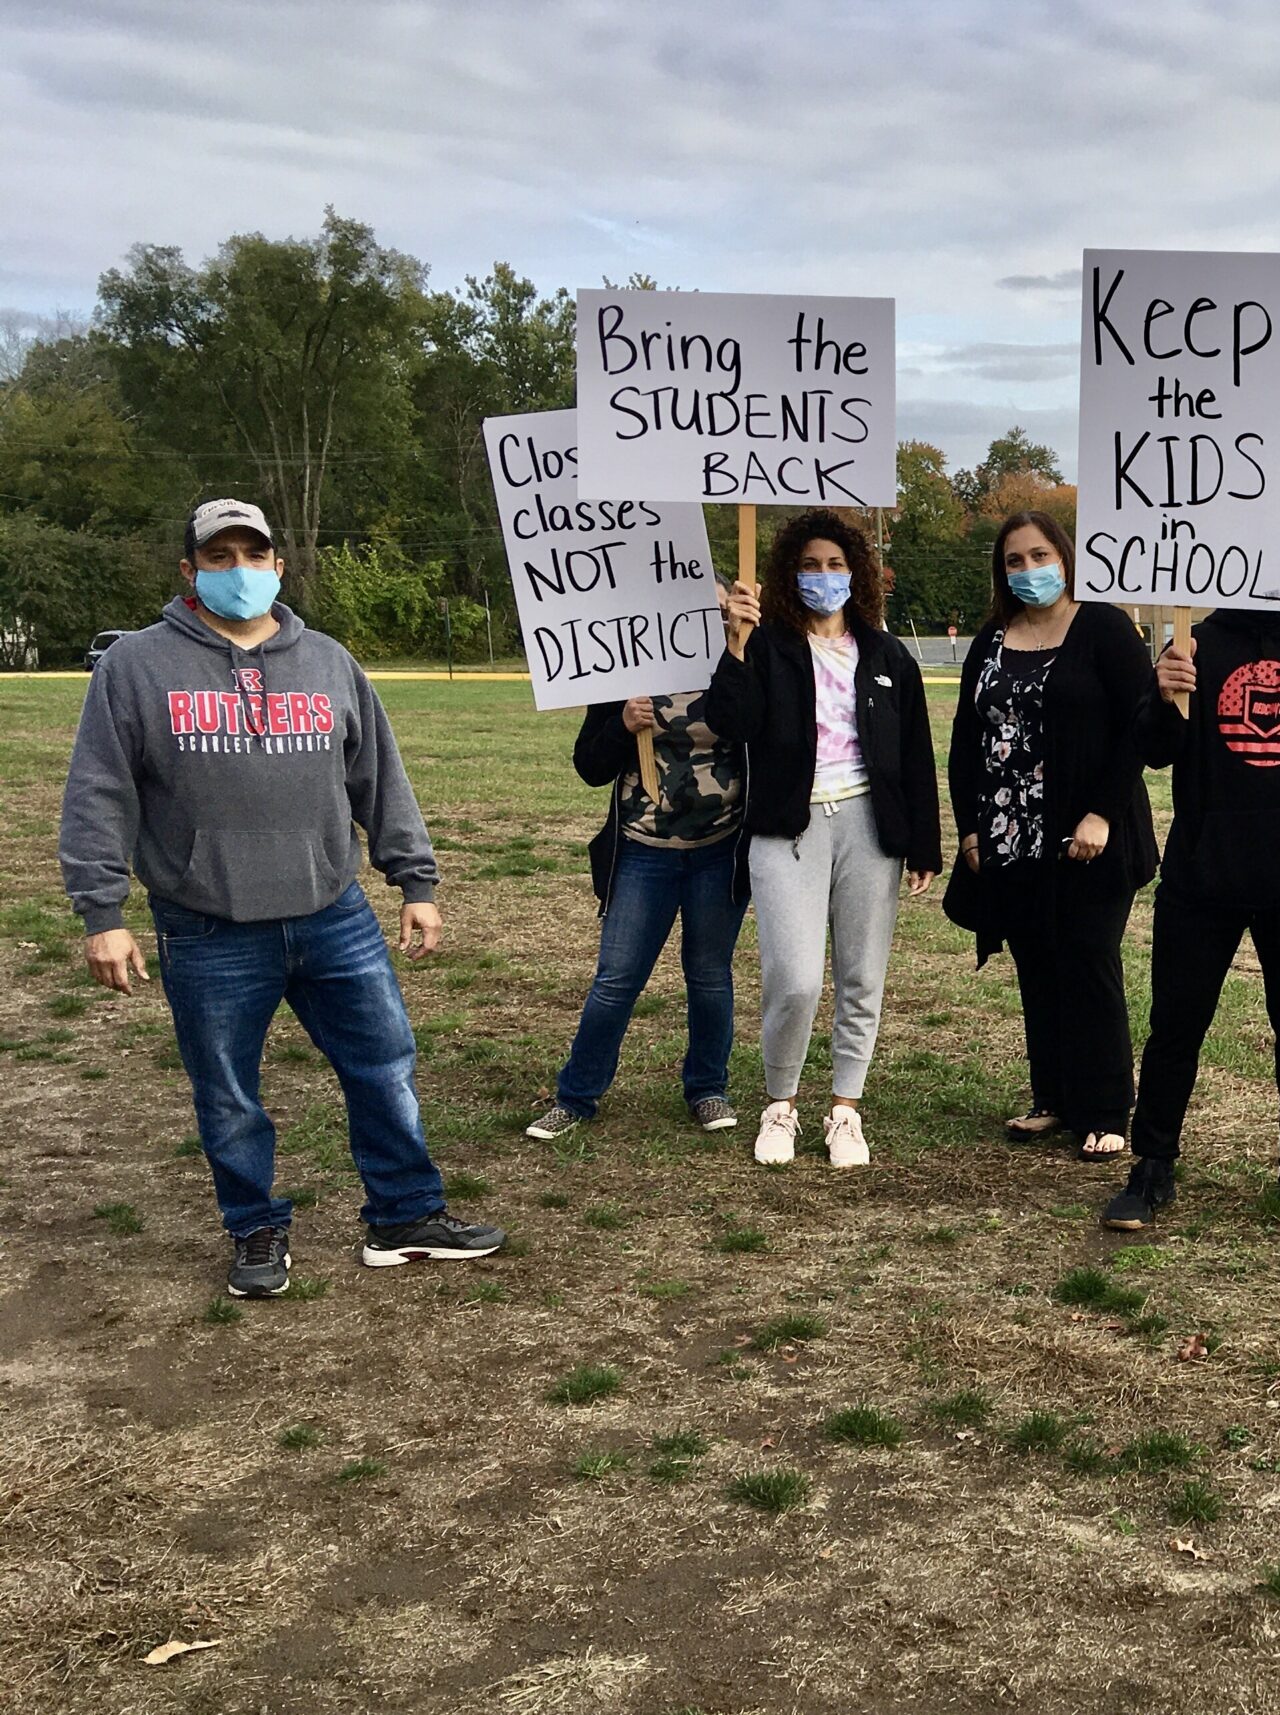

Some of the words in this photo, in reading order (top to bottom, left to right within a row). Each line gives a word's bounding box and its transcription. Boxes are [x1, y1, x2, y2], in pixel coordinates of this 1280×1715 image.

[598, 305, 741, 394] Bring
[787, 312, 868, 375] the
[1093, 266, 1272, 387] Keep
[610, 386, 872, 443] STUDENTS
[1148, 376, 1222, 419] the
[499, 434, 577, 487] Clos
[703, 451, 867, 506] BACK
[1115, 431, 1265, 510] KIDS
[514, 494, 660, 539] classes
[1162, 514, 1195, 540] in
[524, 542, 626, 601] NOT
[650, 541, 704, 583] the
[534, 608, 720, 681] DISTRICT
[232, 668, 264, 692] R
[168, 690, 335, 736] RUTGERS
[178, 735, 253, 754] SCARLET
[264, 734, 331, 755] KNIGHTS
